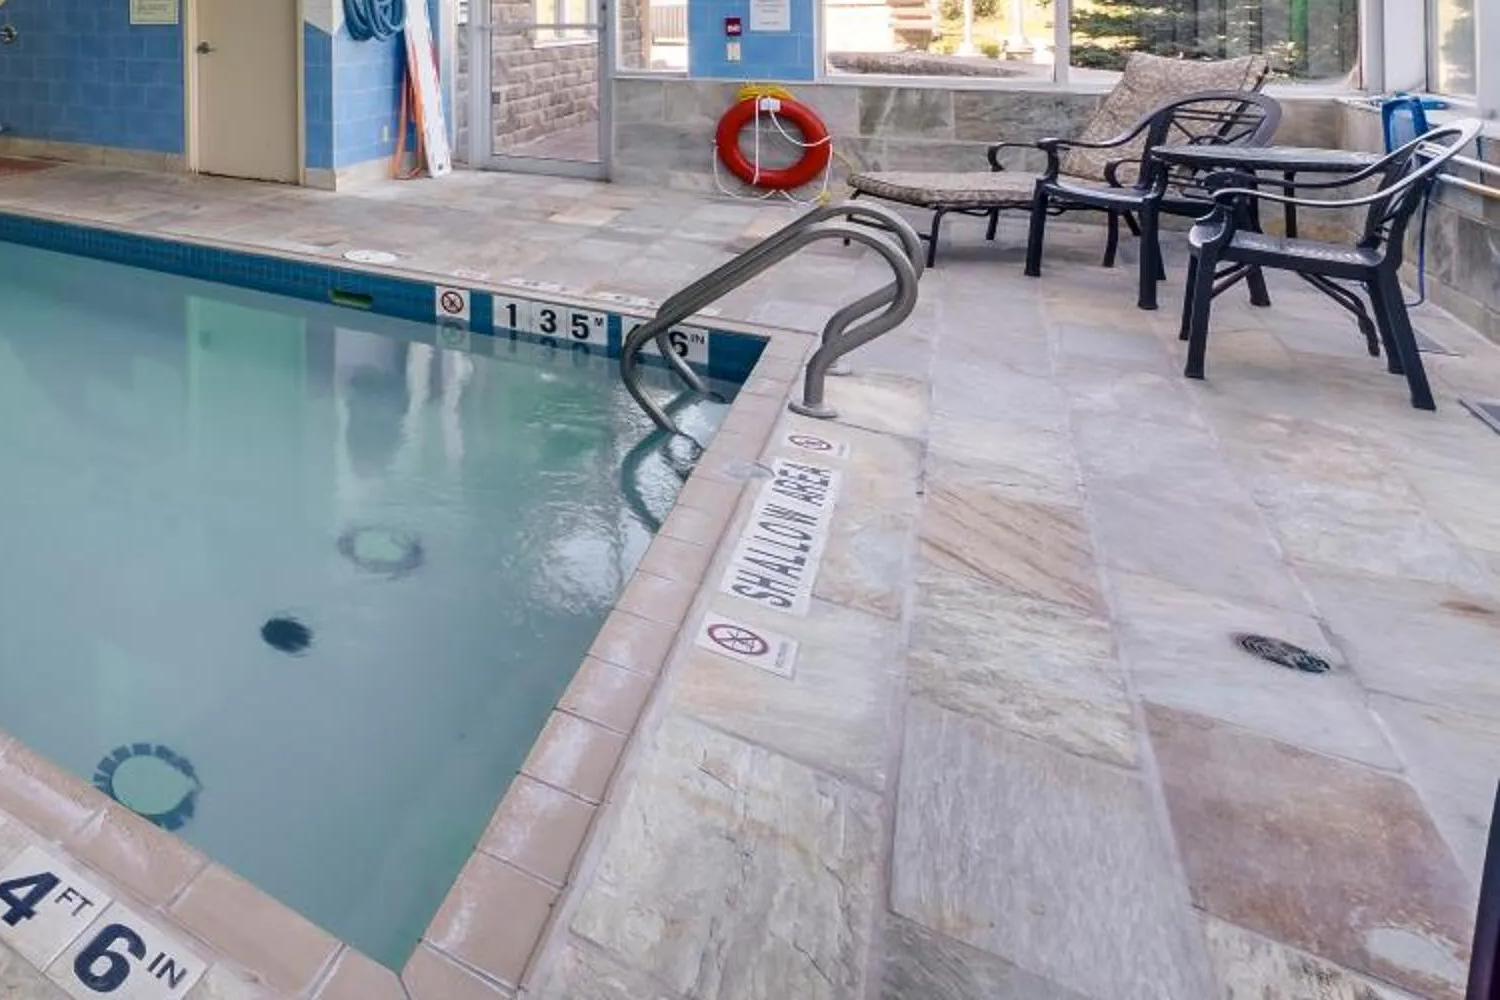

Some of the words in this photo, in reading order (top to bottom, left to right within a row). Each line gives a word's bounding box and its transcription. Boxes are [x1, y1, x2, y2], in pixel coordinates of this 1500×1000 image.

[771, 462, 832, 507] AREA
[731, 503, 818, 609] SHALLOW
[54, 886, 94, 917] FT
[73, 923, 147, 993] 6
[146, 952, 187, 990] IN
